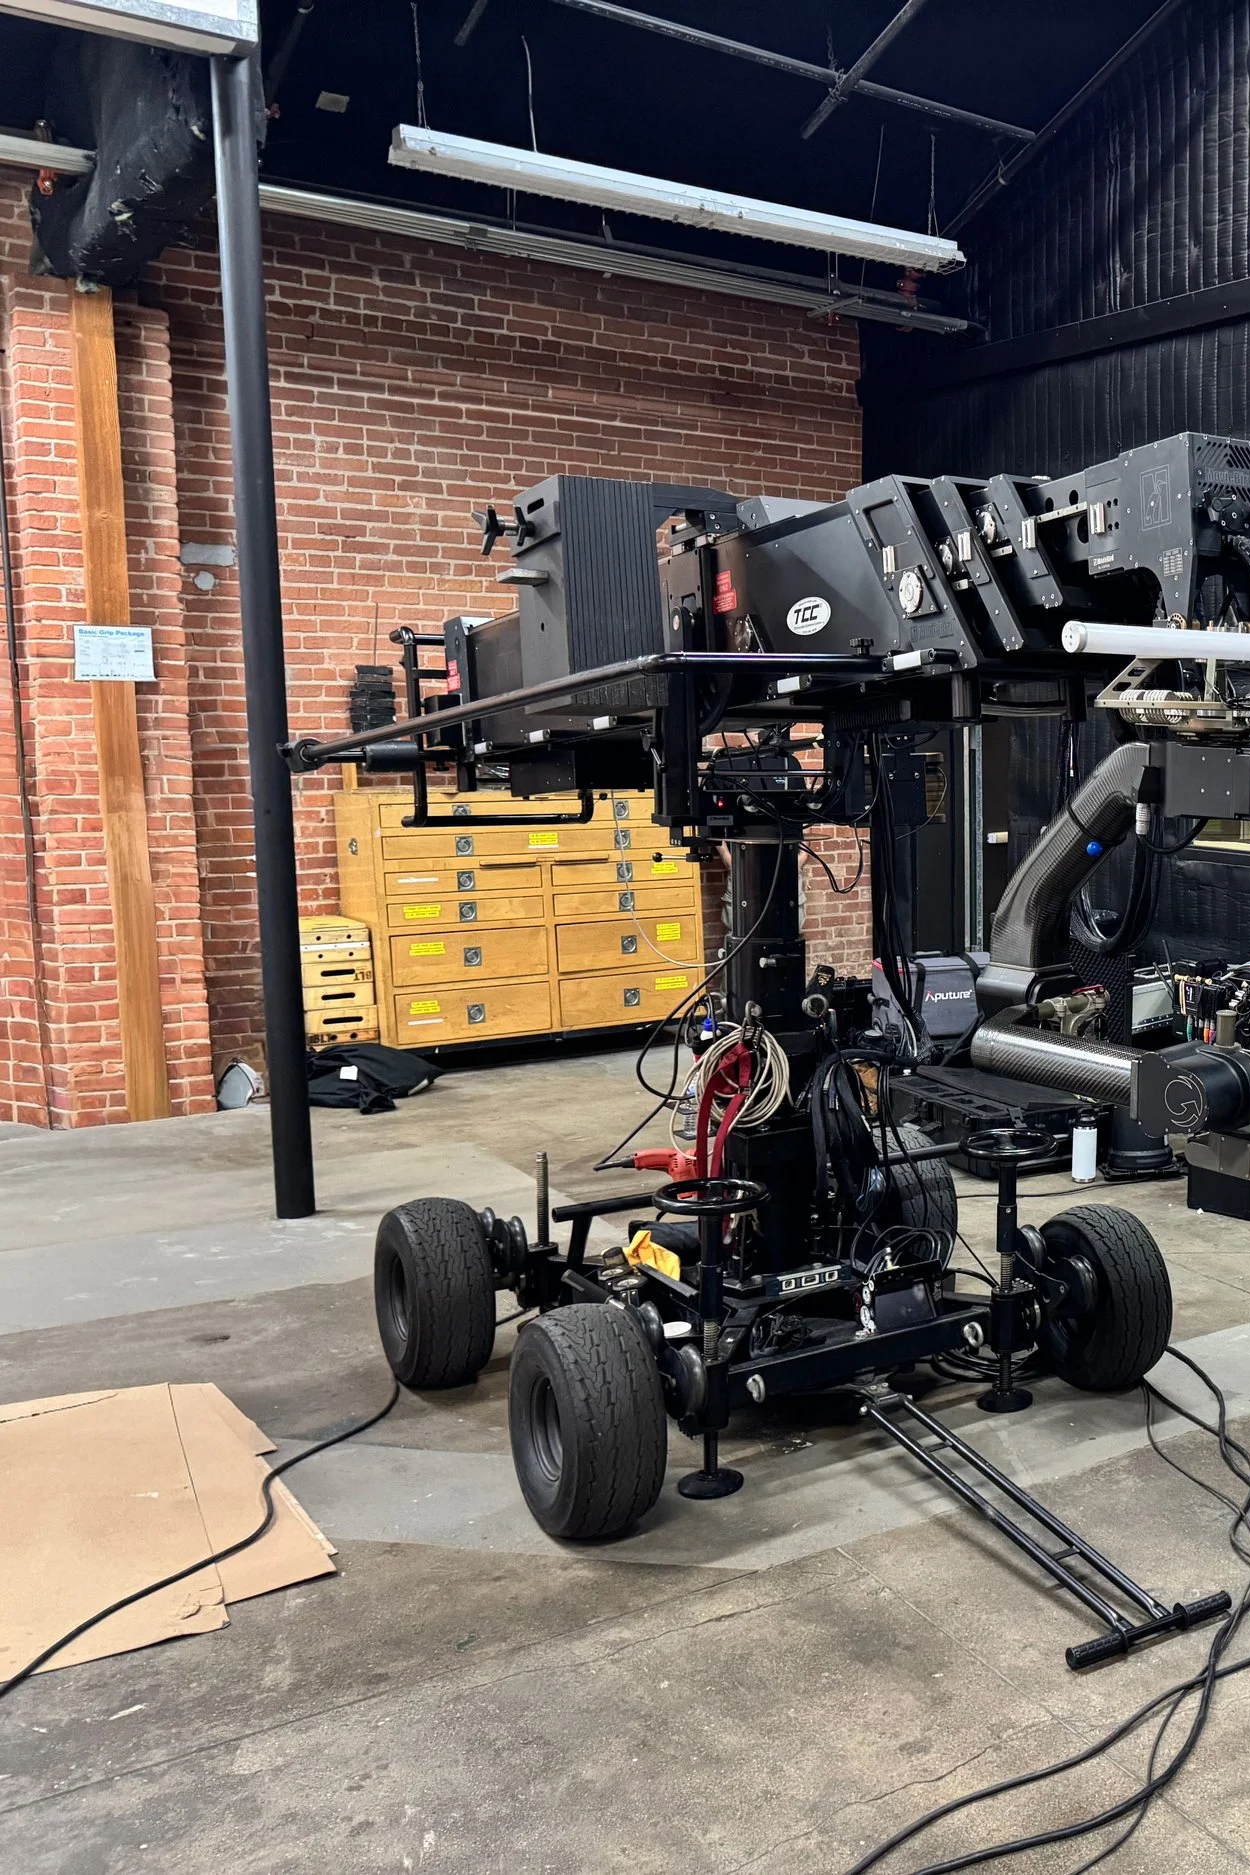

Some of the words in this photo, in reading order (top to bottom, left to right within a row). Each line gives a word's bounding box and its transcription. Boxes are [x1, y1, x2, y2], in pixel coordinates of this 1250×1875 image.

[794, 604, 820, 625] TCC
[99, 629, 114, 637] Grip
[353, 970, 372, 982] BLT
[925, 991, 971, 1003] Aputure
